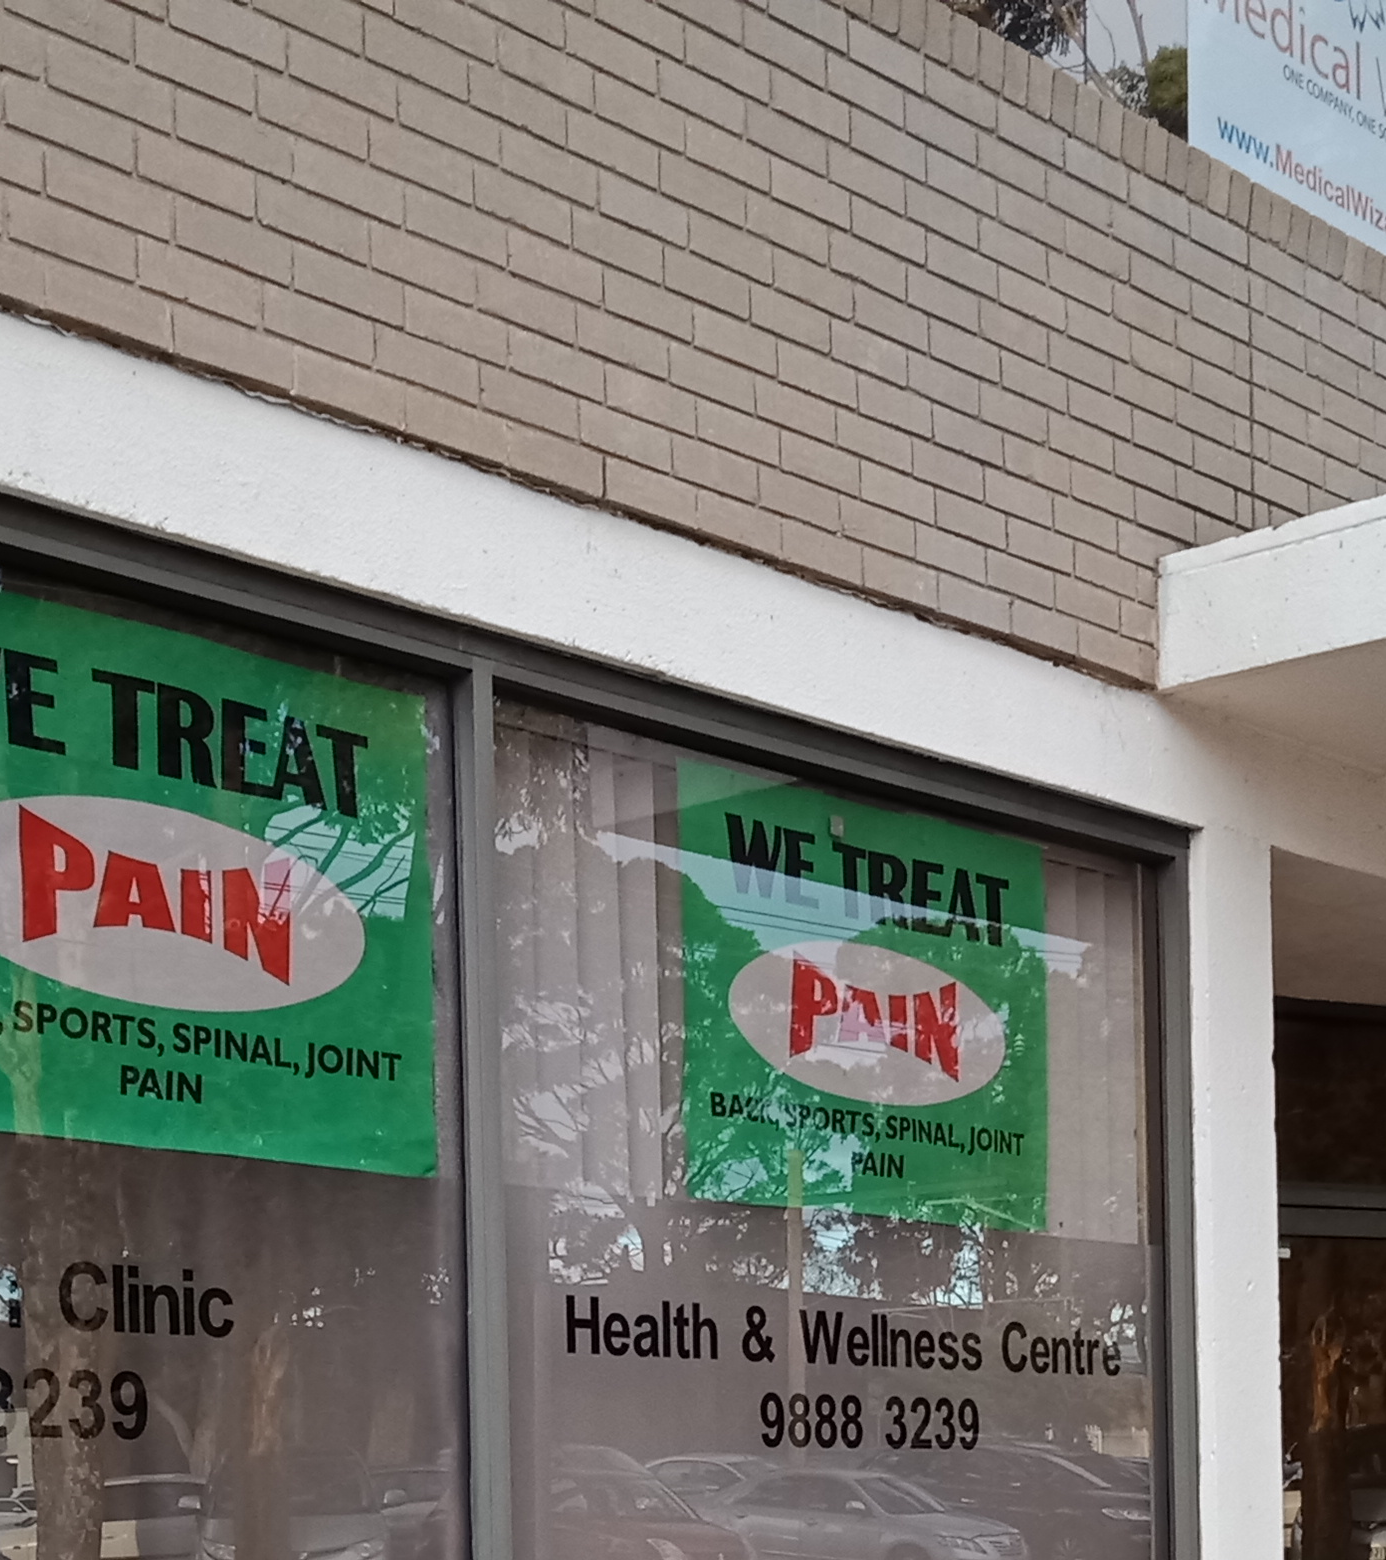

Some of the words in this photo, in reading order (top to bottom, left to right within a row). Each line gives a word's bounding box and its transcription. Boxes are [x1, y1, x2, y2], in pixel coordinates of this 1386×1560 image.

[1283, 64, 1304, 90] ONE
[1306, 79, 1354, 123] COMPANY,
[1356, 110, 1376, 135] ONE
[91, 667, 368, 818] TREAT
[18, 803, 291, 987] PAIN
[724, 811, 819, 909] WE
[831, 839, 1010, 948] TREAT
[13, 1001, 166, 1058] SPORTS,
[172, 1022, 300, 1076] SPINAL,
[304, 1042, 403, 1081] JOINT
[789, 950, 960, 1083] PAIN
[120, 1064, 202, 1105] PAIN
[709, 1091, 779, 1131] BACK,
[786, 1102, 881, 1143] SPORTS,
[885, 1114, 965, 1154] SPINAL,
[968, 1126, 1025, 1156] JOINT
[851, 1150, 904, 1179] PAIN
[58, 1260, 235, 1338] Clinic
[564, 1294, 719, 1360] Health
[741, 1304, 776, 1364] &
[799, 1307, 983, 1372] Wellness
[1001, 1320, 1122, 1377] Centre
[759, 1391, 864, 1449] 9888
[885, 1395, 980, 1450] 3239
